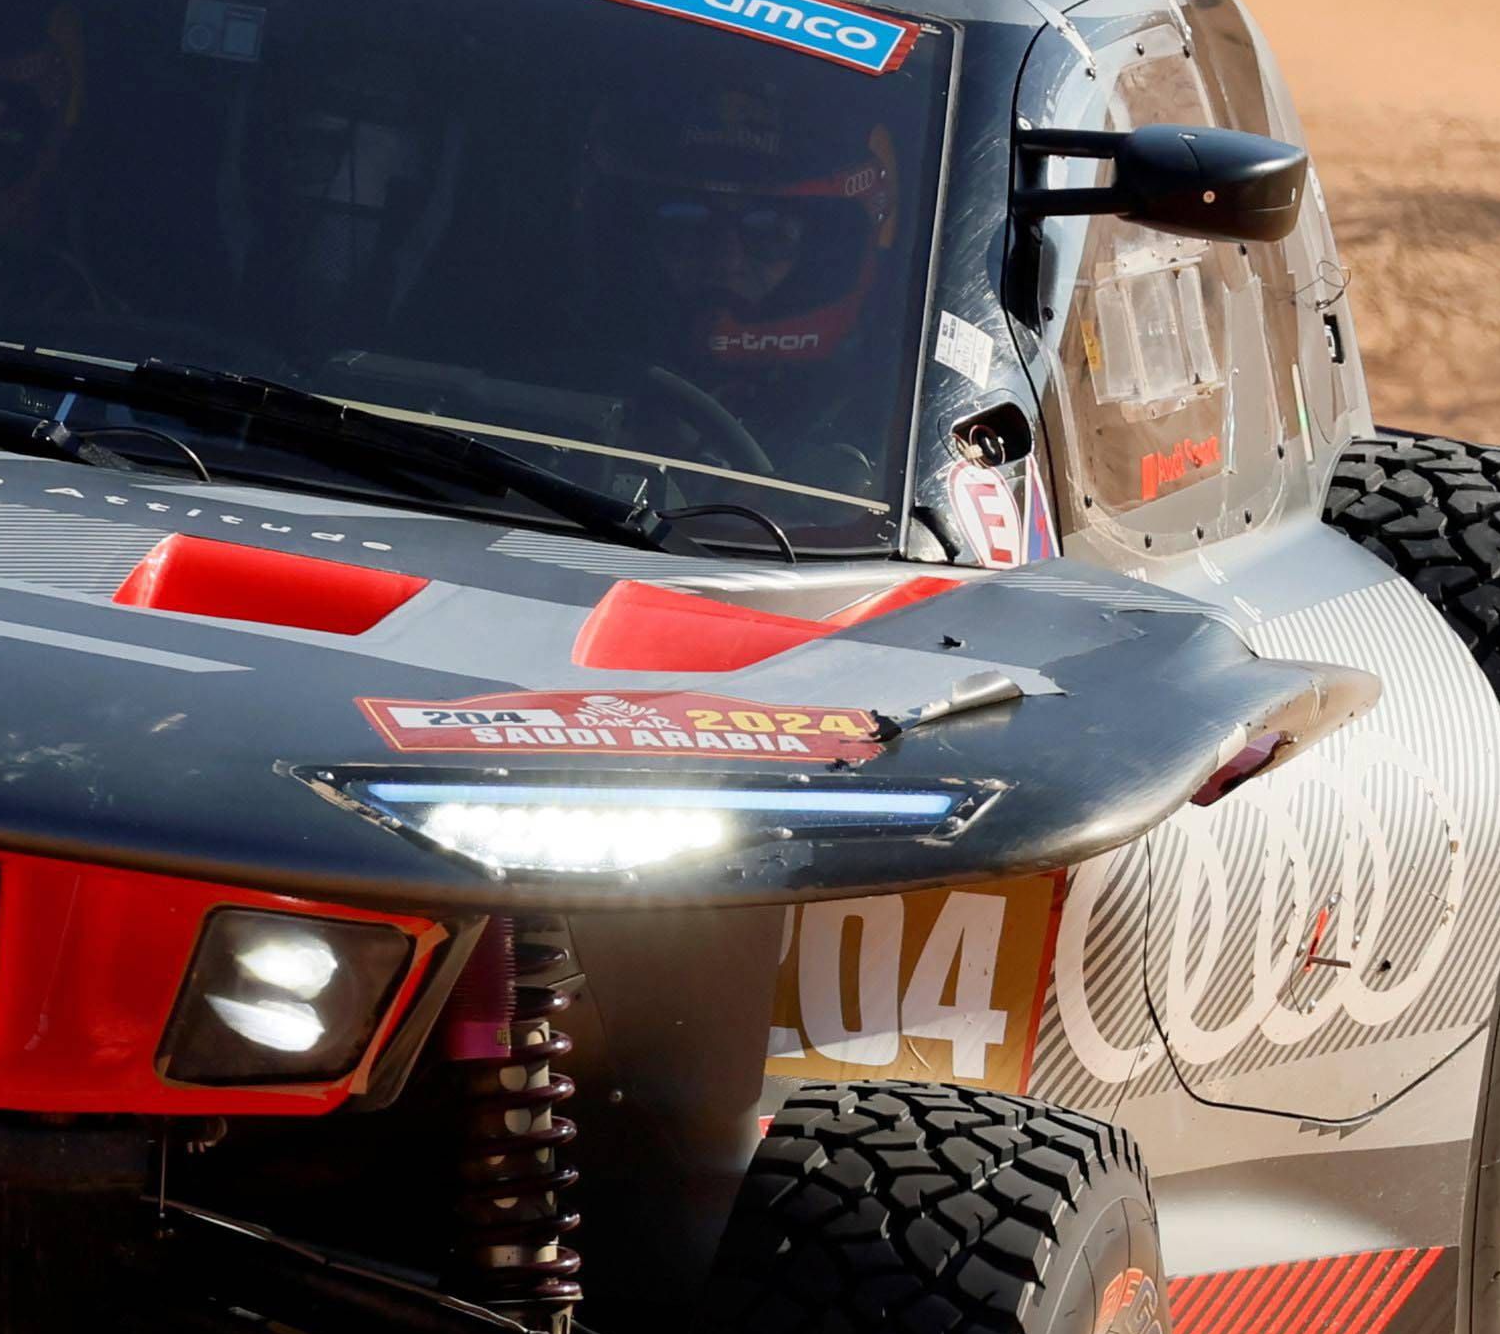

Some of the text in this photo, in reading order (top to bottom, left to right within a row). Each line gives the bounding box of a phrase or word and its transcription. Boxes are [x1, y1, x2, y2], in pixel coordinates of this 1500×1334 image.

[44, 486, 393, 552] Attitude
[423, 709, 867, 737] 204 DAKAR 2024
[471, 725, 811, 754] SAUDI ARABIA
